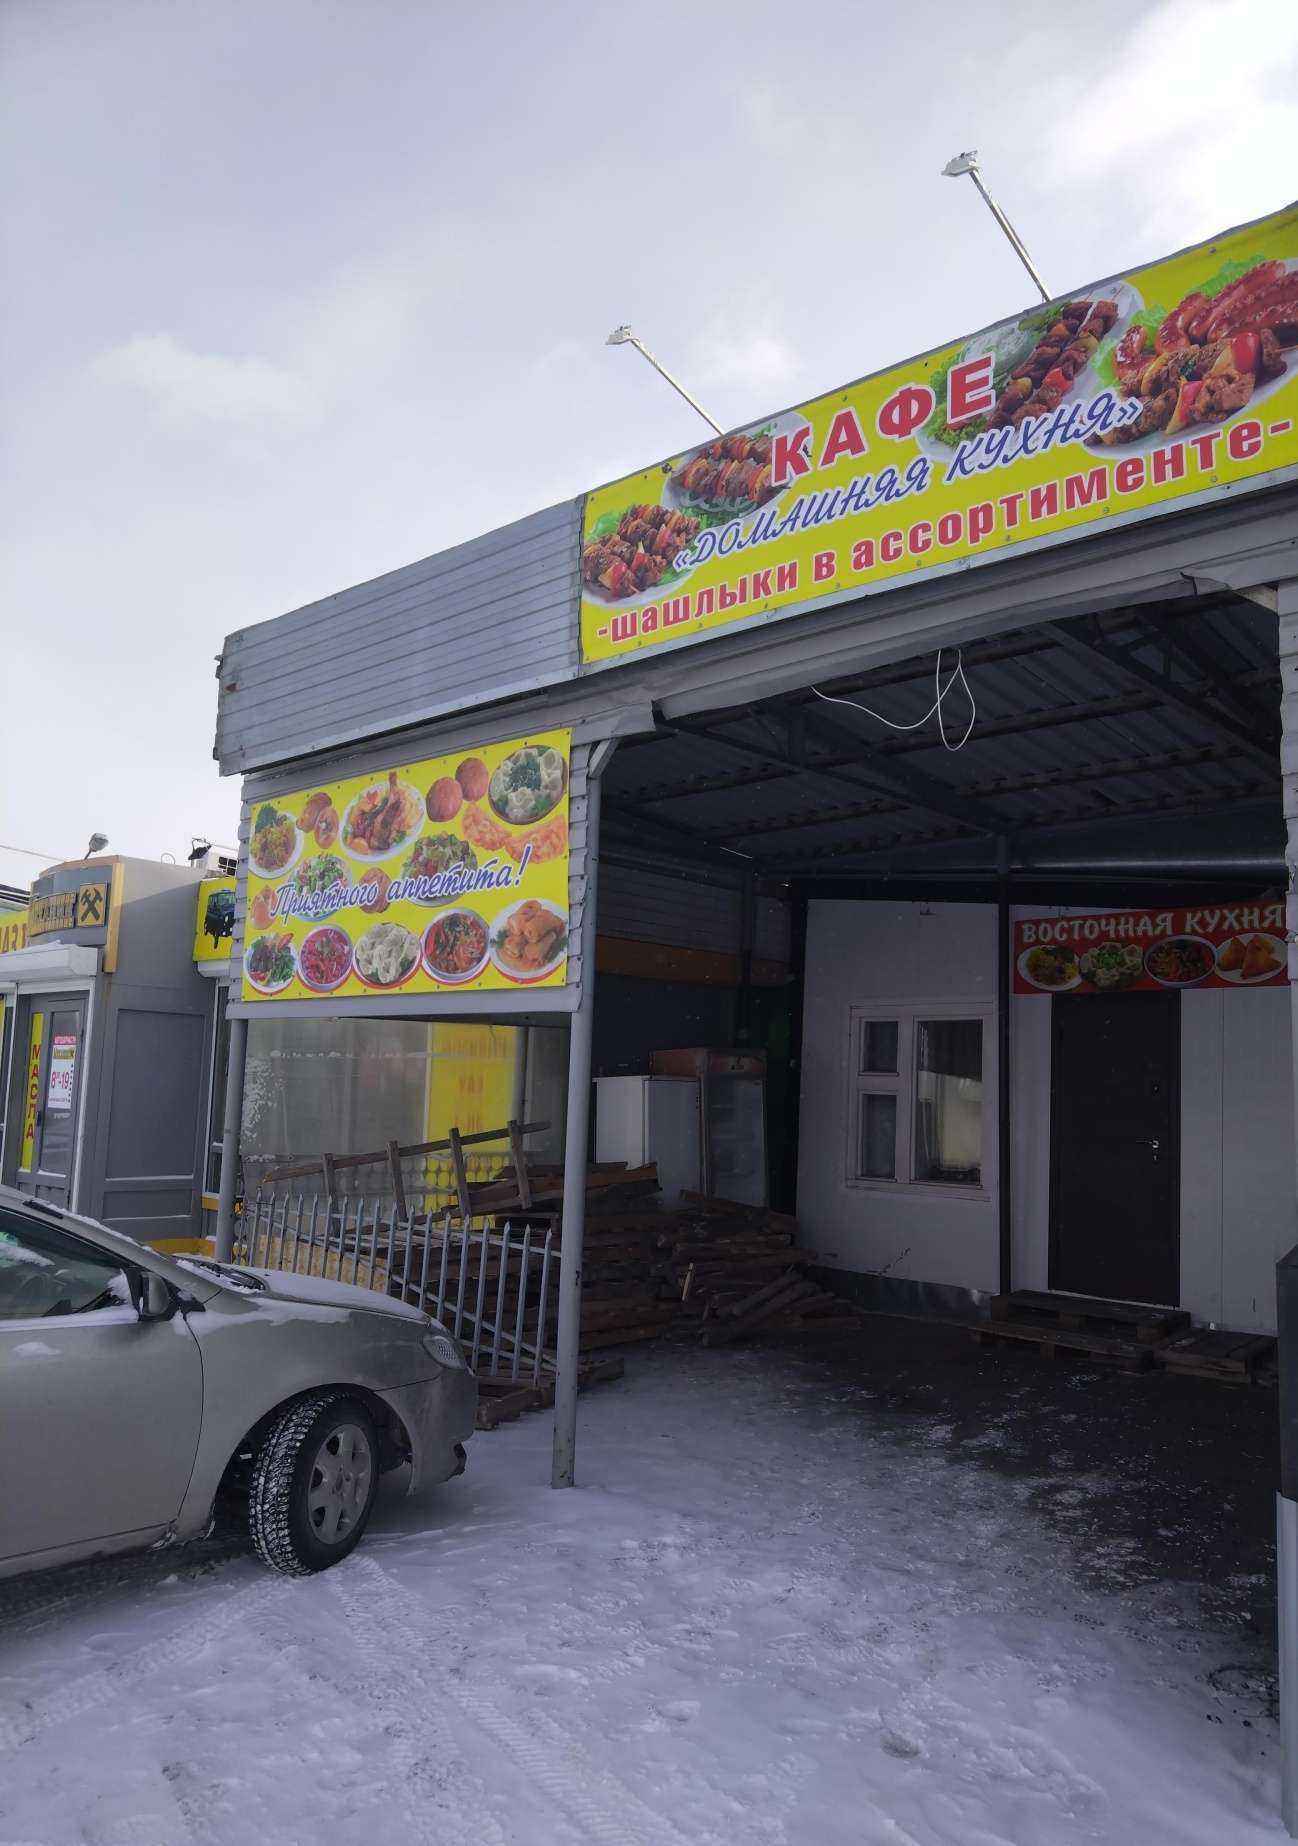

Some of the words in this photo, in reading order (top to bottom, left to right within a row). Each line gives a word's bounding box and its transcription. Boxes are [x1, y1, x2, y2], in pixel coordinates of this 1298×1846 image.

[773, 356, 993, 484] КАФЕ
[813, 551, 836, 582] в
[270, 882, 379, 925] Приятного
[387, 845, 532, 901] аппетита!
[1023, 912, 1174, 943] ВОСТОЧНАЯ
[1185, 904, 1286, 934] КУХНЯ
[26, 1044, 41, 1140] МАСЛА
